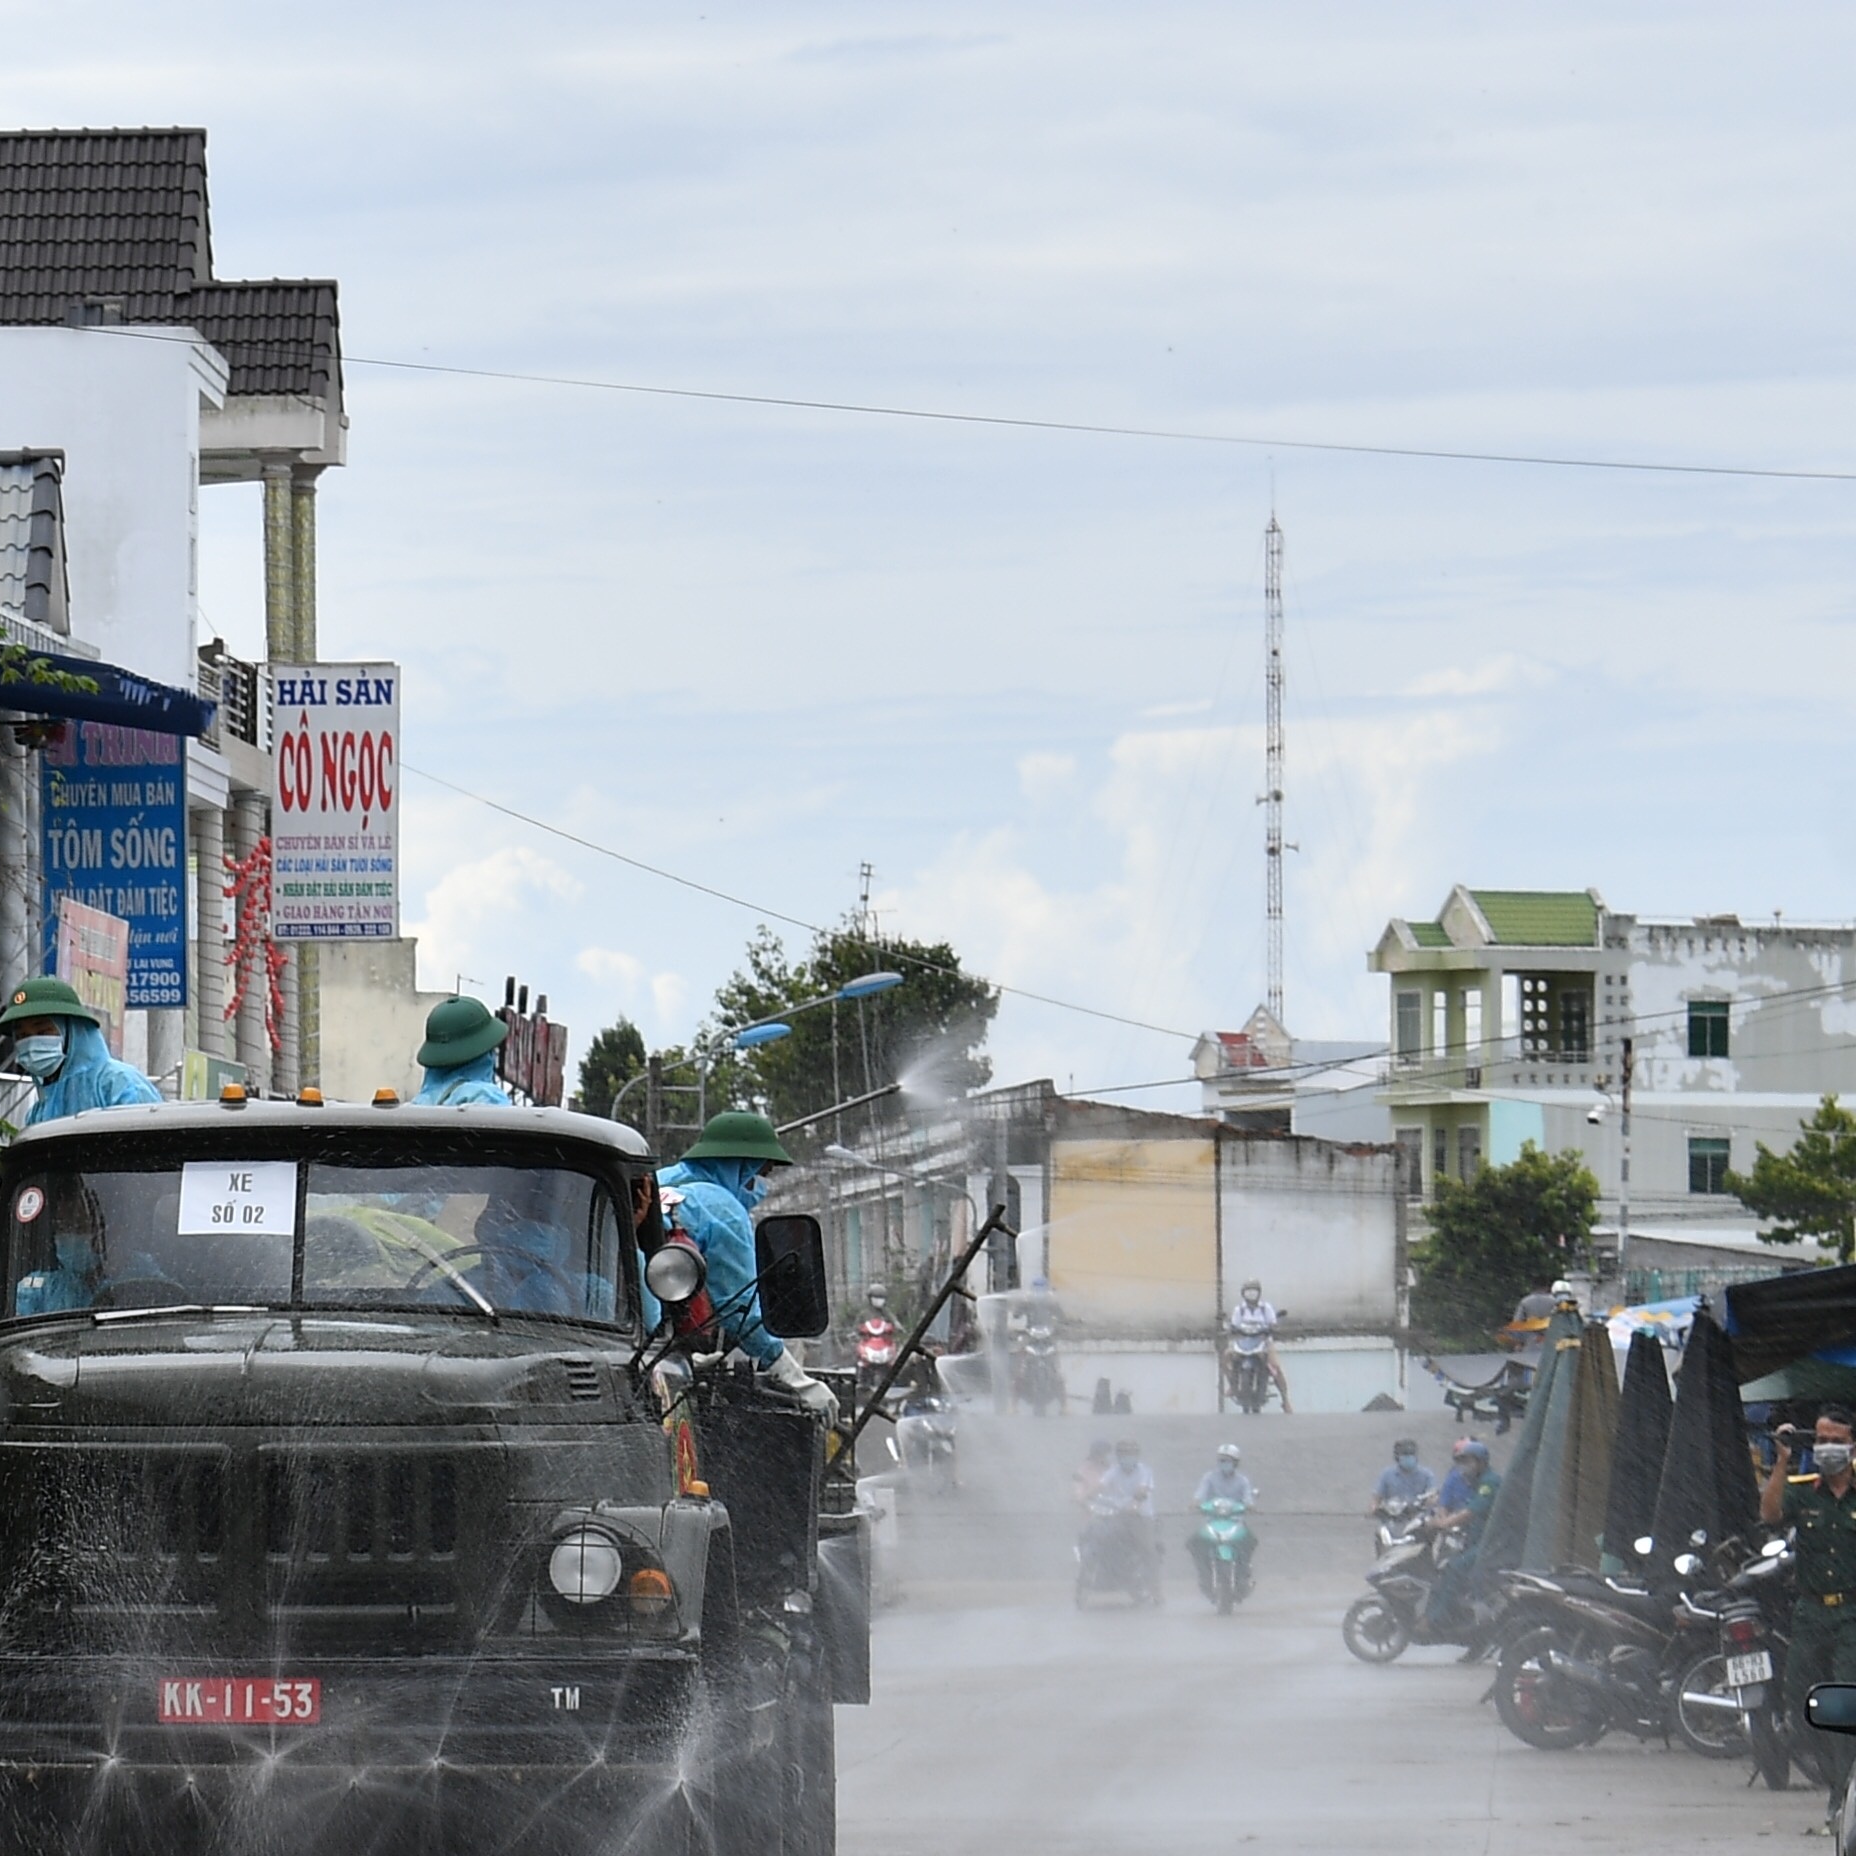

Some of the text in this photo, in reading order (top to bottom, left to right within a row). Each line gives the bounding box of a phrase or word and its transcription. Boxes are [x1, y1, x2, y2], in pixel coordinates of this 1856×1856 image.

[277, 669, 394, 706] HẢI SẢN
[279, 708, 392, 830] CÔ NGỌC
[51, 776, 175, 807] CHUYÊN MUA BÁN
[48, 812, 176, 870] TÔM SỐNG
[117, 879, 178, 921] ĐÁM TIỆC
[127, 972, 180, 986] 17900
[127, 988, 181, 1004] 56599
[228, 1173, 253, 1192] XE
[211, 1200, 264, 1224] SỐ 02
[164, 1681, 313, 1719] KK-11-53
[550, 1687, 580, 1710] TM
